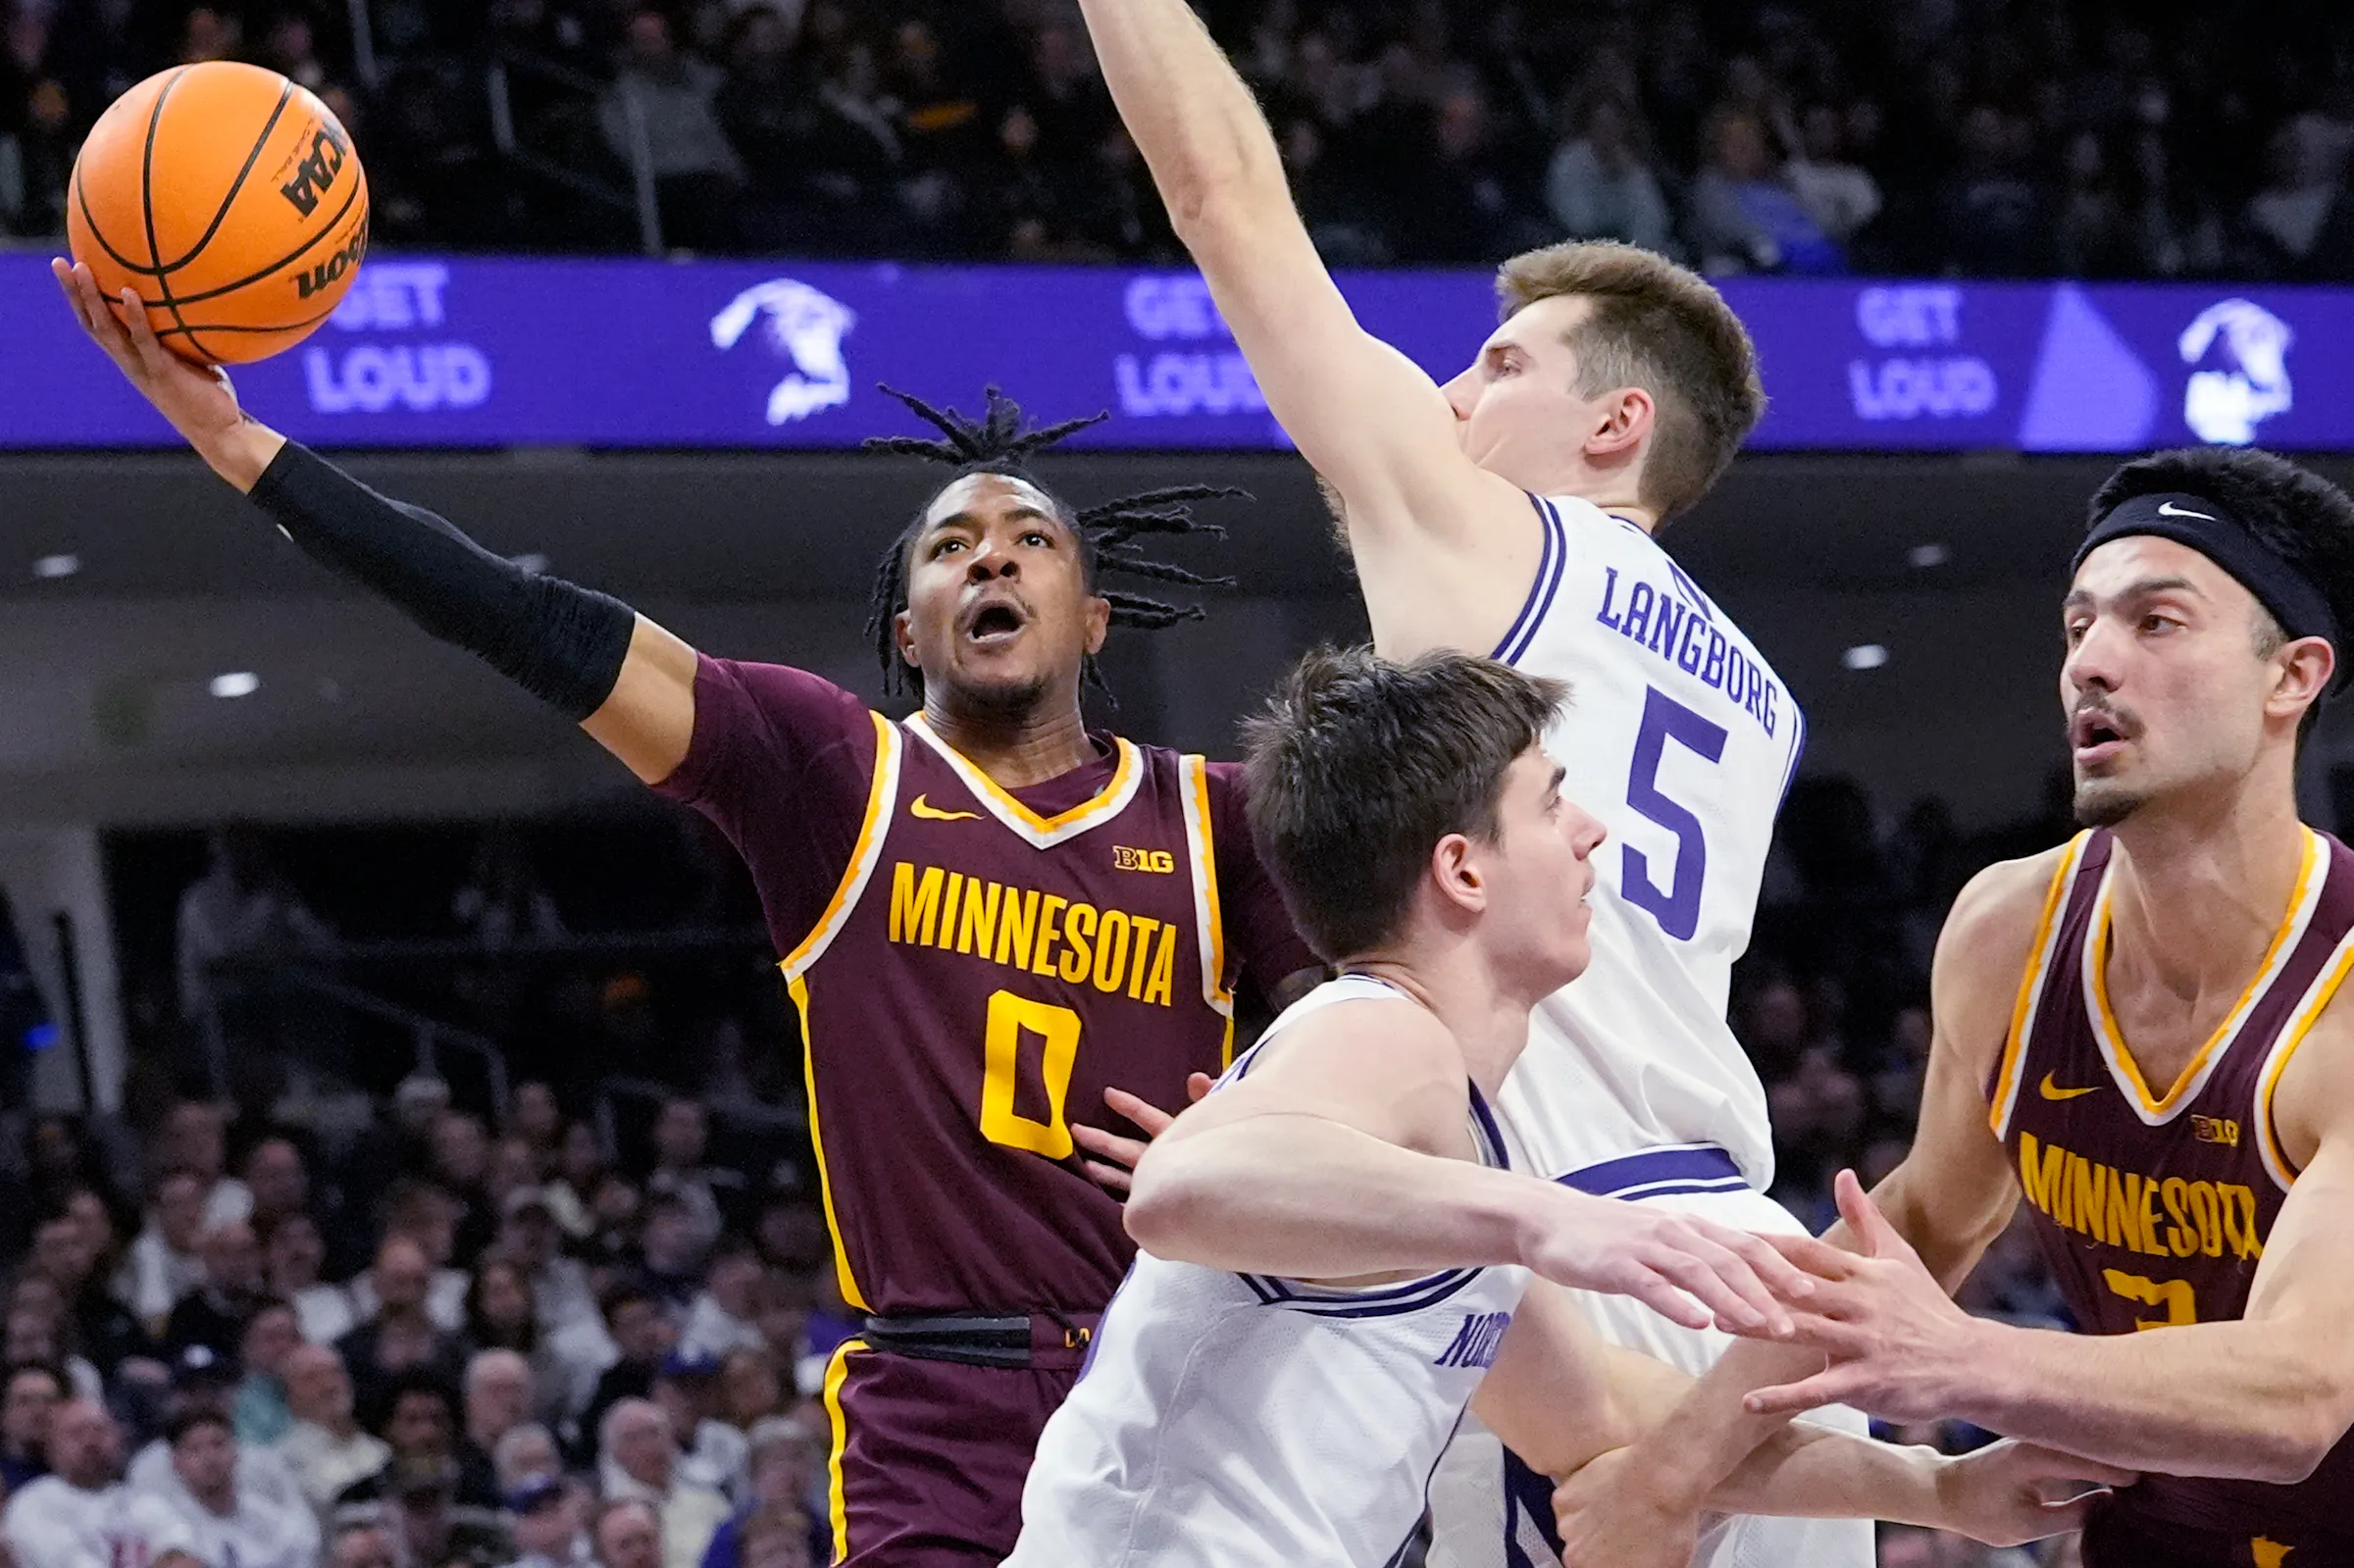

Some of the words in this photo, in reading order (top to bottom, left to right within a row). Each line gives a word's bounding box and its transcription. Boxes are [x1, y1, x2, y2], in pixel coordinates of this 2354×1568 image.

[1124, 276, 1230, 339] GE
[1858, 286, 1961, 346] GET
[304, 345, 491, 413] LOUD
[1849, 357, 1998, 420] LOUD
[1596, 566, 1778, 740] LANGBORG
[1621, 683, 1729, 941] 5
[889, 861, 1177, 1008] MINNESOTA
[980, 988, 1082, 1161] 0
